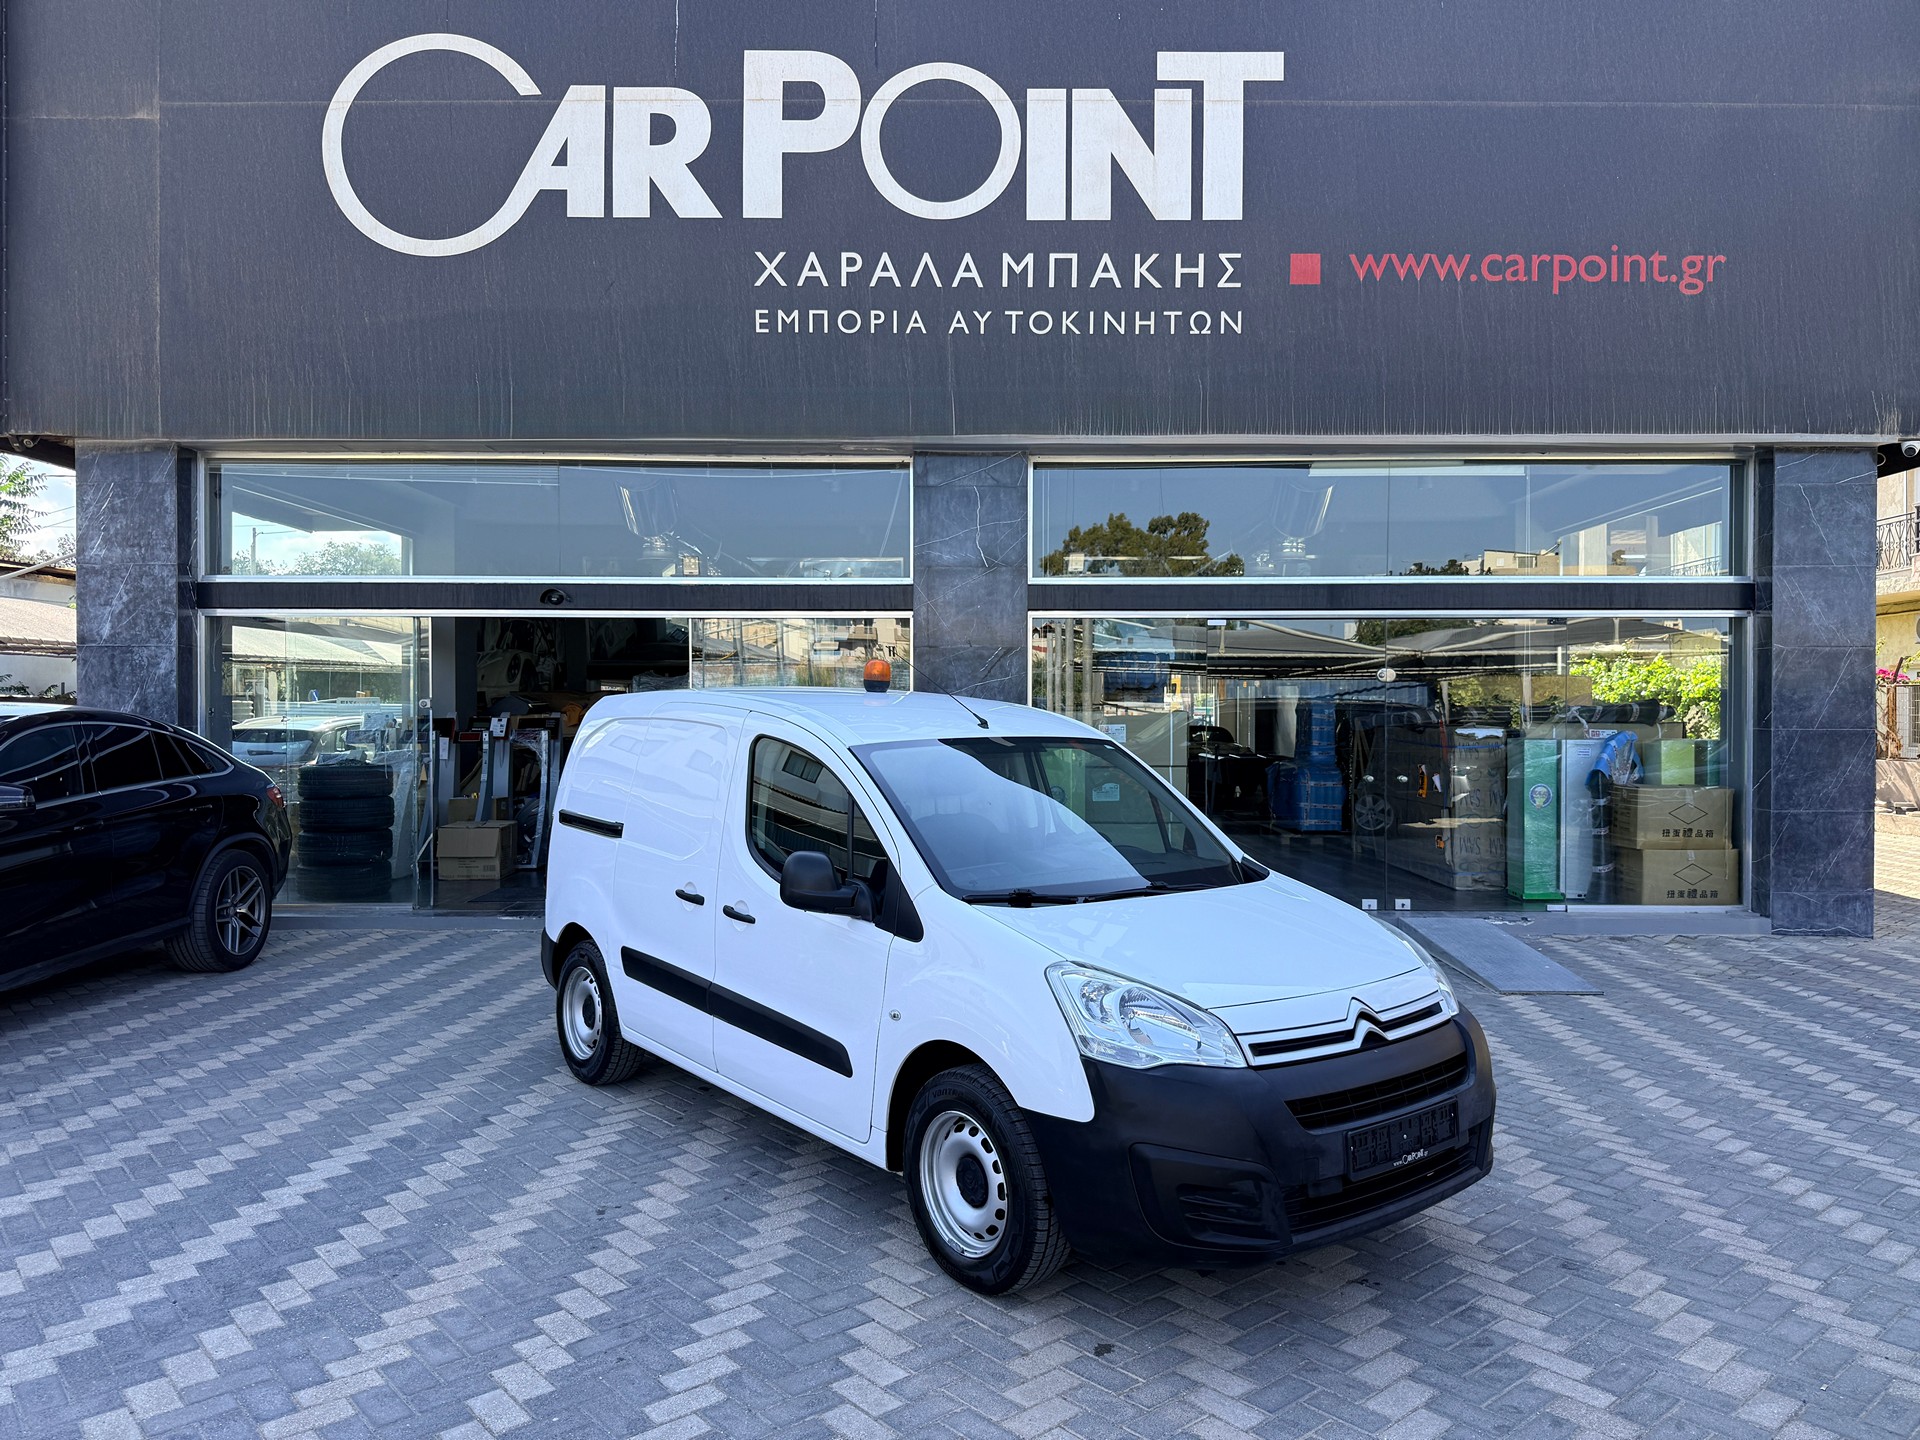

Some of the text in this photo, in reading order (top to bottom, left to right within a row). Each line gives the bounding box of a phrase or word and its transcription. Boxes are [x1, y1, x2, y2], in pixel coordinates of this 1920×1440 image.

[1348, 244, 1728, 295] www.carpoint.gr
[755, 309, 1243, 336] ΕΜΠΟΡΙΑ ΑΥΤΟΚΙΝΗΤΩΝ
